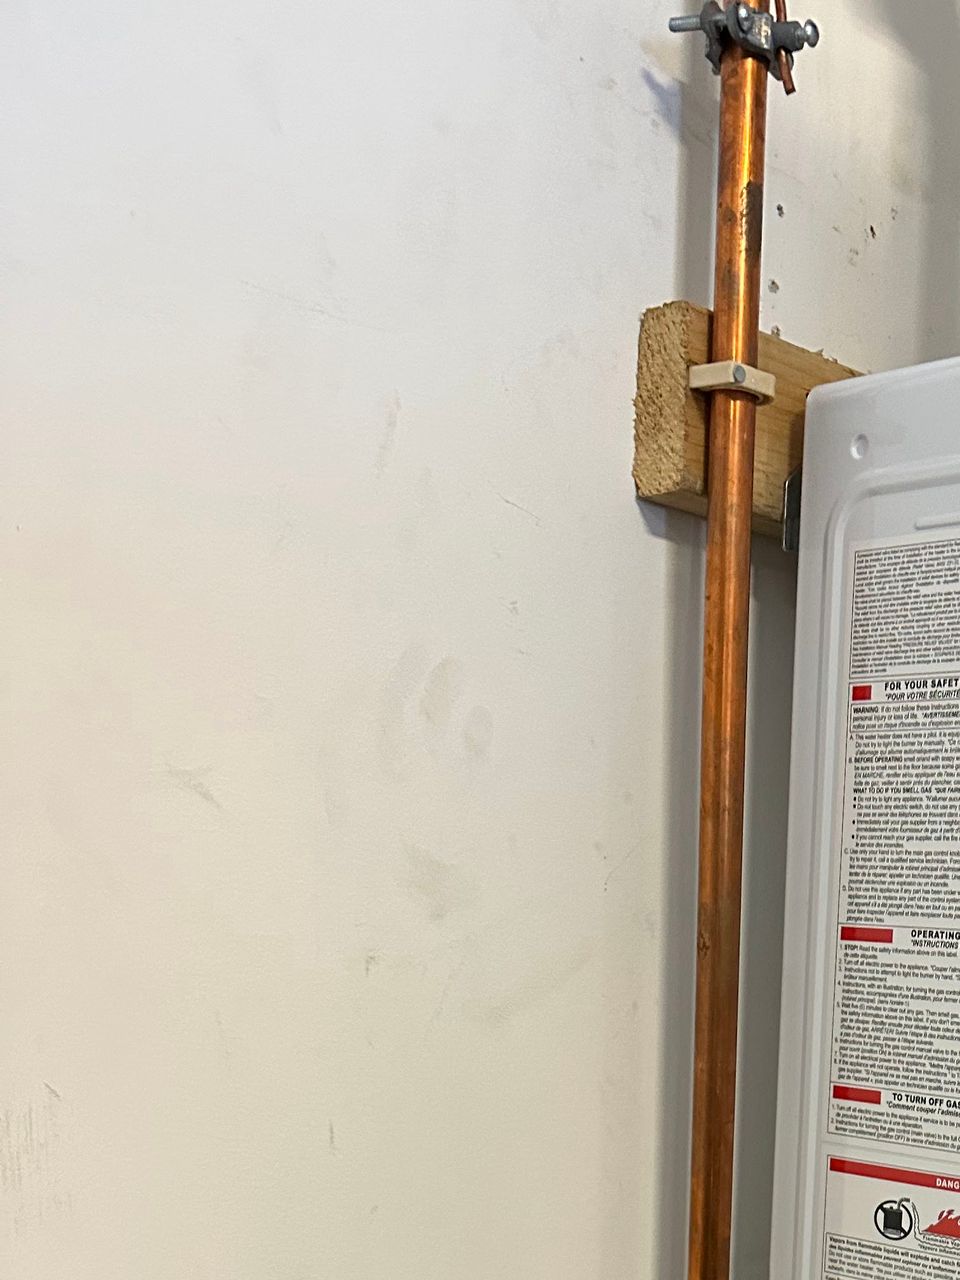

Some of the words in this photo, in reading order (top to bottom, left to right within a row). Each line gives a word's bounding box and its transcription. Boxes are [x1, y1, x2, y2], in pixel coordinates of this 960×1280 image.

[884, 681, 901, 691] FOR
[904, 679, 927, 689] YOUR
[906, 690, 927, 699] VOTRE
[910, 928, 960, 940] OPERATING
[891, 1092, 903, 1101] TO
[904, 1093, 926, 1105] TURN
[927, 1096, 944, 1107] OFF
[915, 1106, 936, 1115] couper
